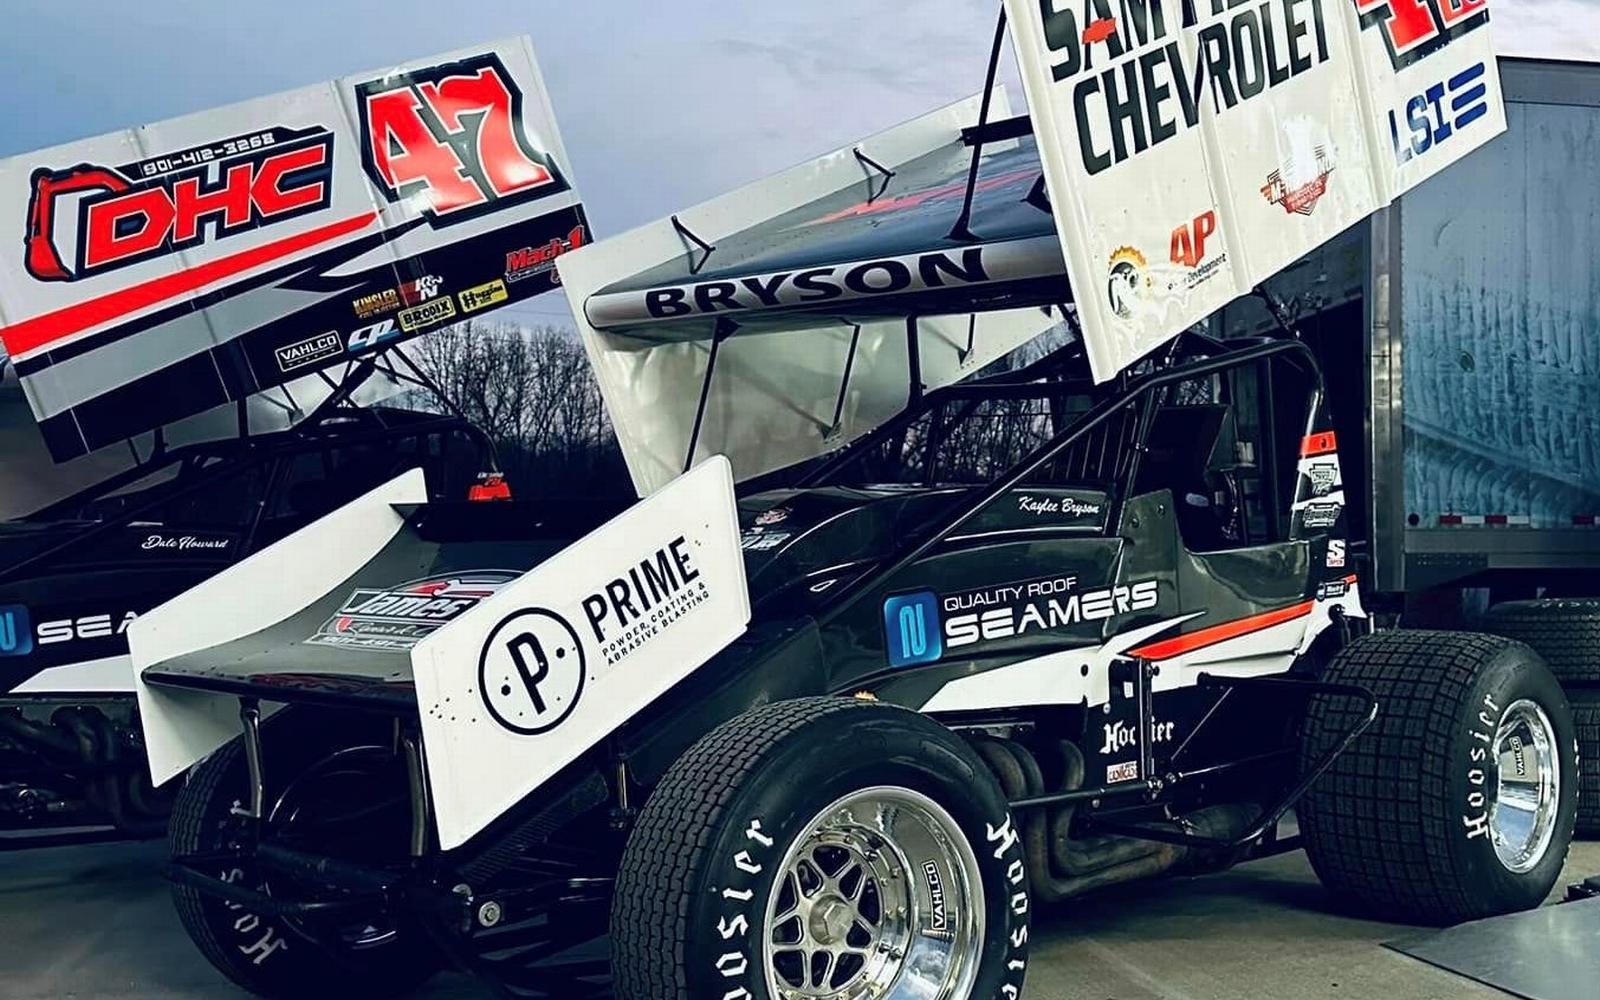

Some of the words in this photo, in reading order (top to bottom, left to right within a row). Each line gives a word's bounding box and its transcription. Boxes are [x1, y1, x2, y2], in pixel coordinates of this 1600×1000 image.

[1073, 0, 1330, 176] CHEVROLET
[366, 66, 555, 217] 47
[83, 142, 326, 269] DHC
[1169, 210, 1216, 269] AP
[402, 300, 451, 324] BRODIX
[645, 246, 991, 319] BRYSON
[280, 335, 338, 360] VAHLCO
[1018, 495, 1059, 515] Kaylee
[1062, 497, 1100, 517] Bryson
[141, 534, 178, 549] Dale
[178, 535, 230, 550] Howard
[582, 535, 700, 645] PRIME
[650, 588, 696, 623] COATING
[943, 585, 1024, 612] QUALITY
[1027, 576, 1078, 597] ROOF
[945, 580, 1159, 648] SEAMERS
[606, 628, 660, 667] ABRASIVE
[661, 590, 711, 629] BLASTING
[506, 632, 549, 715] P
[1463, 693, 1500, 839] Hoosier
[925, 862, 946, 928] VAHLCO
